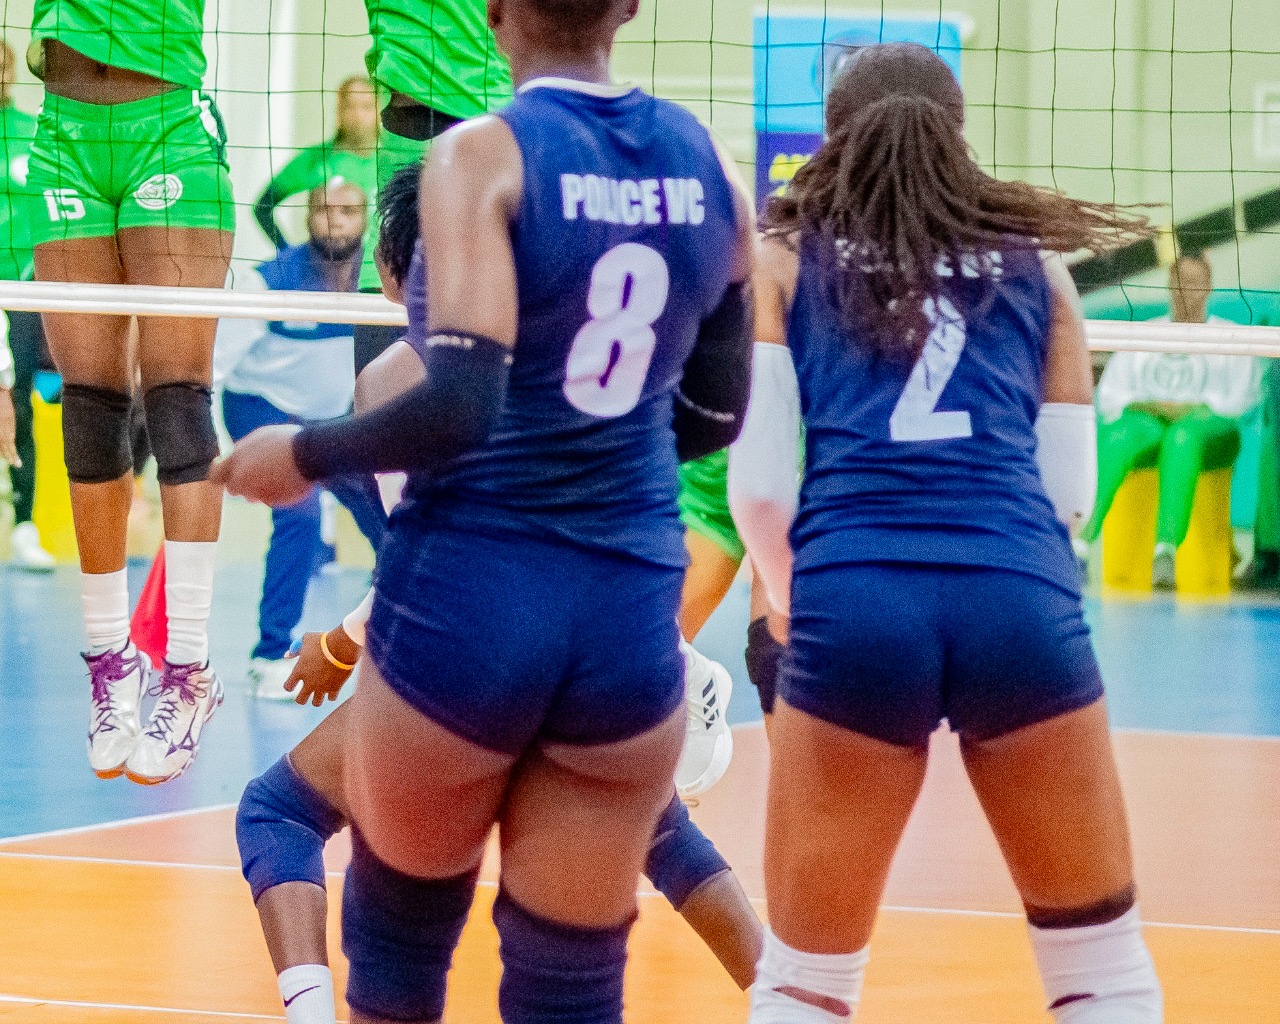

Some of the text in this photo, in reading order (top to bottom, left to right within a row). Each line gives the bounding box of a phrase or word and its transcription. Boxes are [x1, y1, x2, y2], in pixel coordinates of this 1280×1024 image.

[43, 188, 86, 222] 15
[561, 173, 705, 226] POLICE VC
[562, 241, 670, 418] 8
[888, 294, 973, 442] 2
